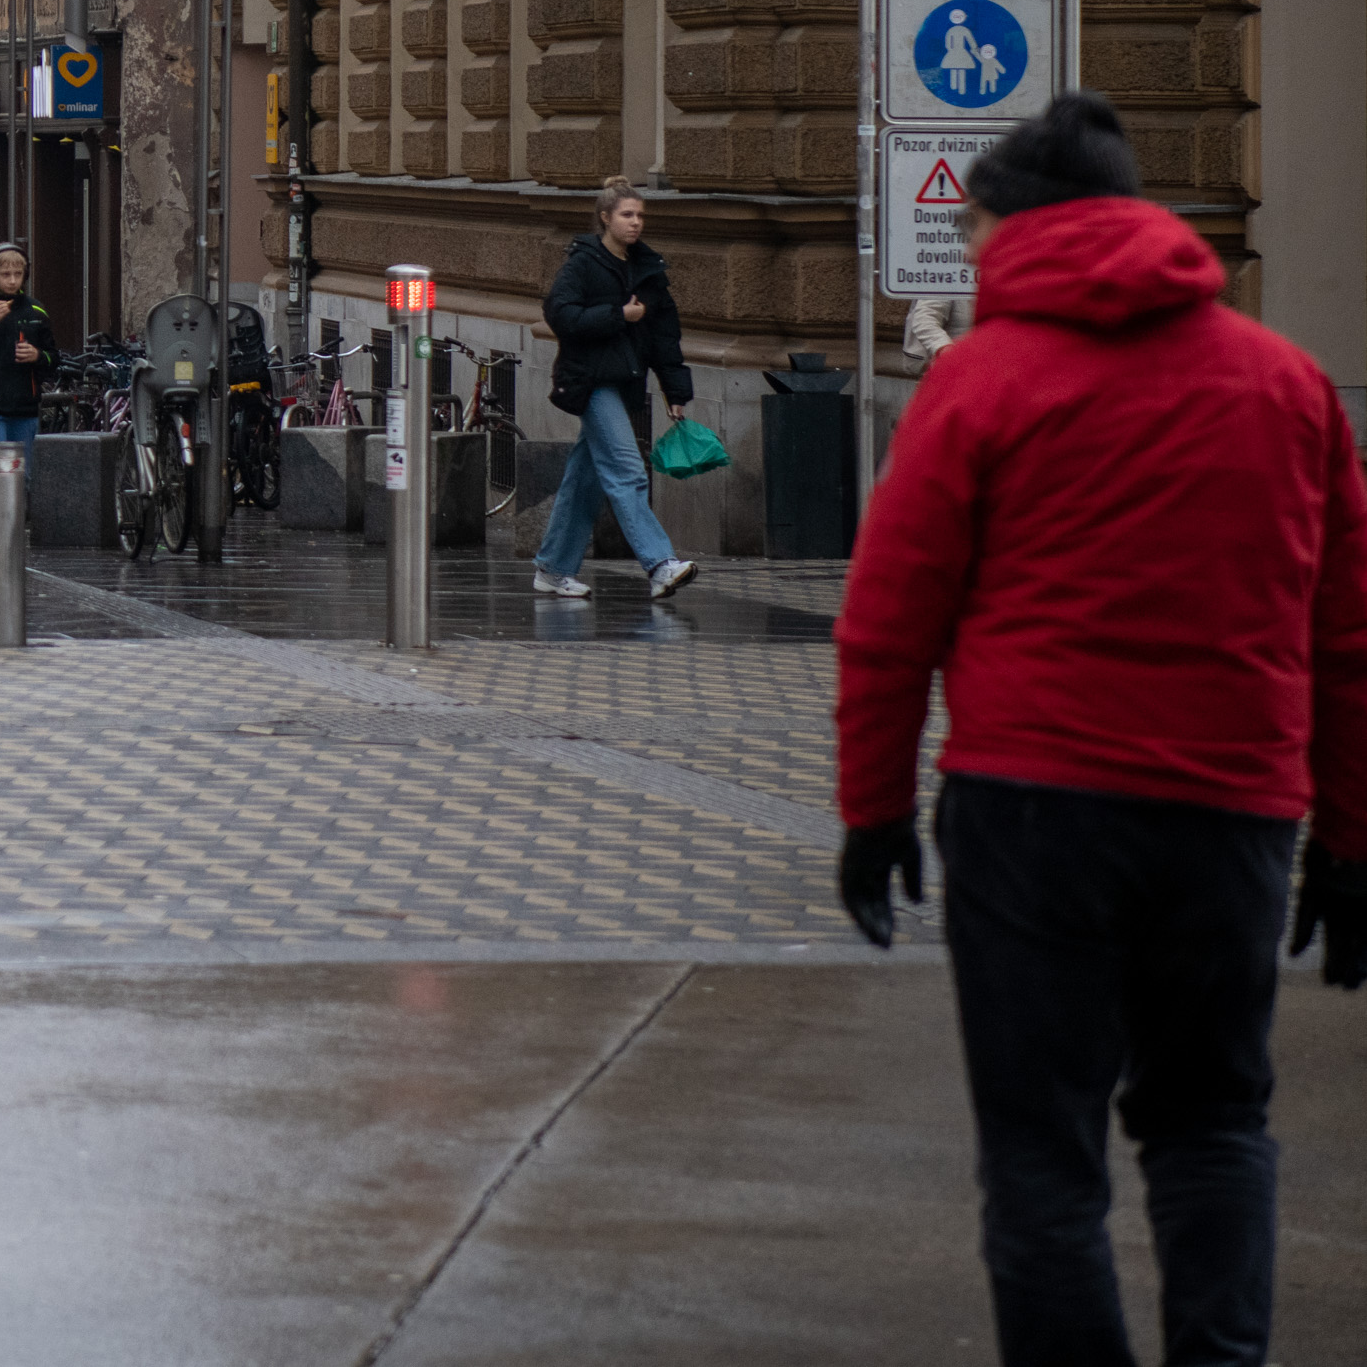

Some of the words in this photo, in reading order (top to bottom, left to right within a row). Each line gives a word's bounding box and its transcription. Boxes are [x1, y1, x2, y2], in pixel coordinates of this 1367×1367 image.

[66, 102, 98, 112] mlinar
[894, 137, 936, 153] Pozor,
[938, 138, 977, 153] dvižni
[897, 269, 956, 284] Dostava:
